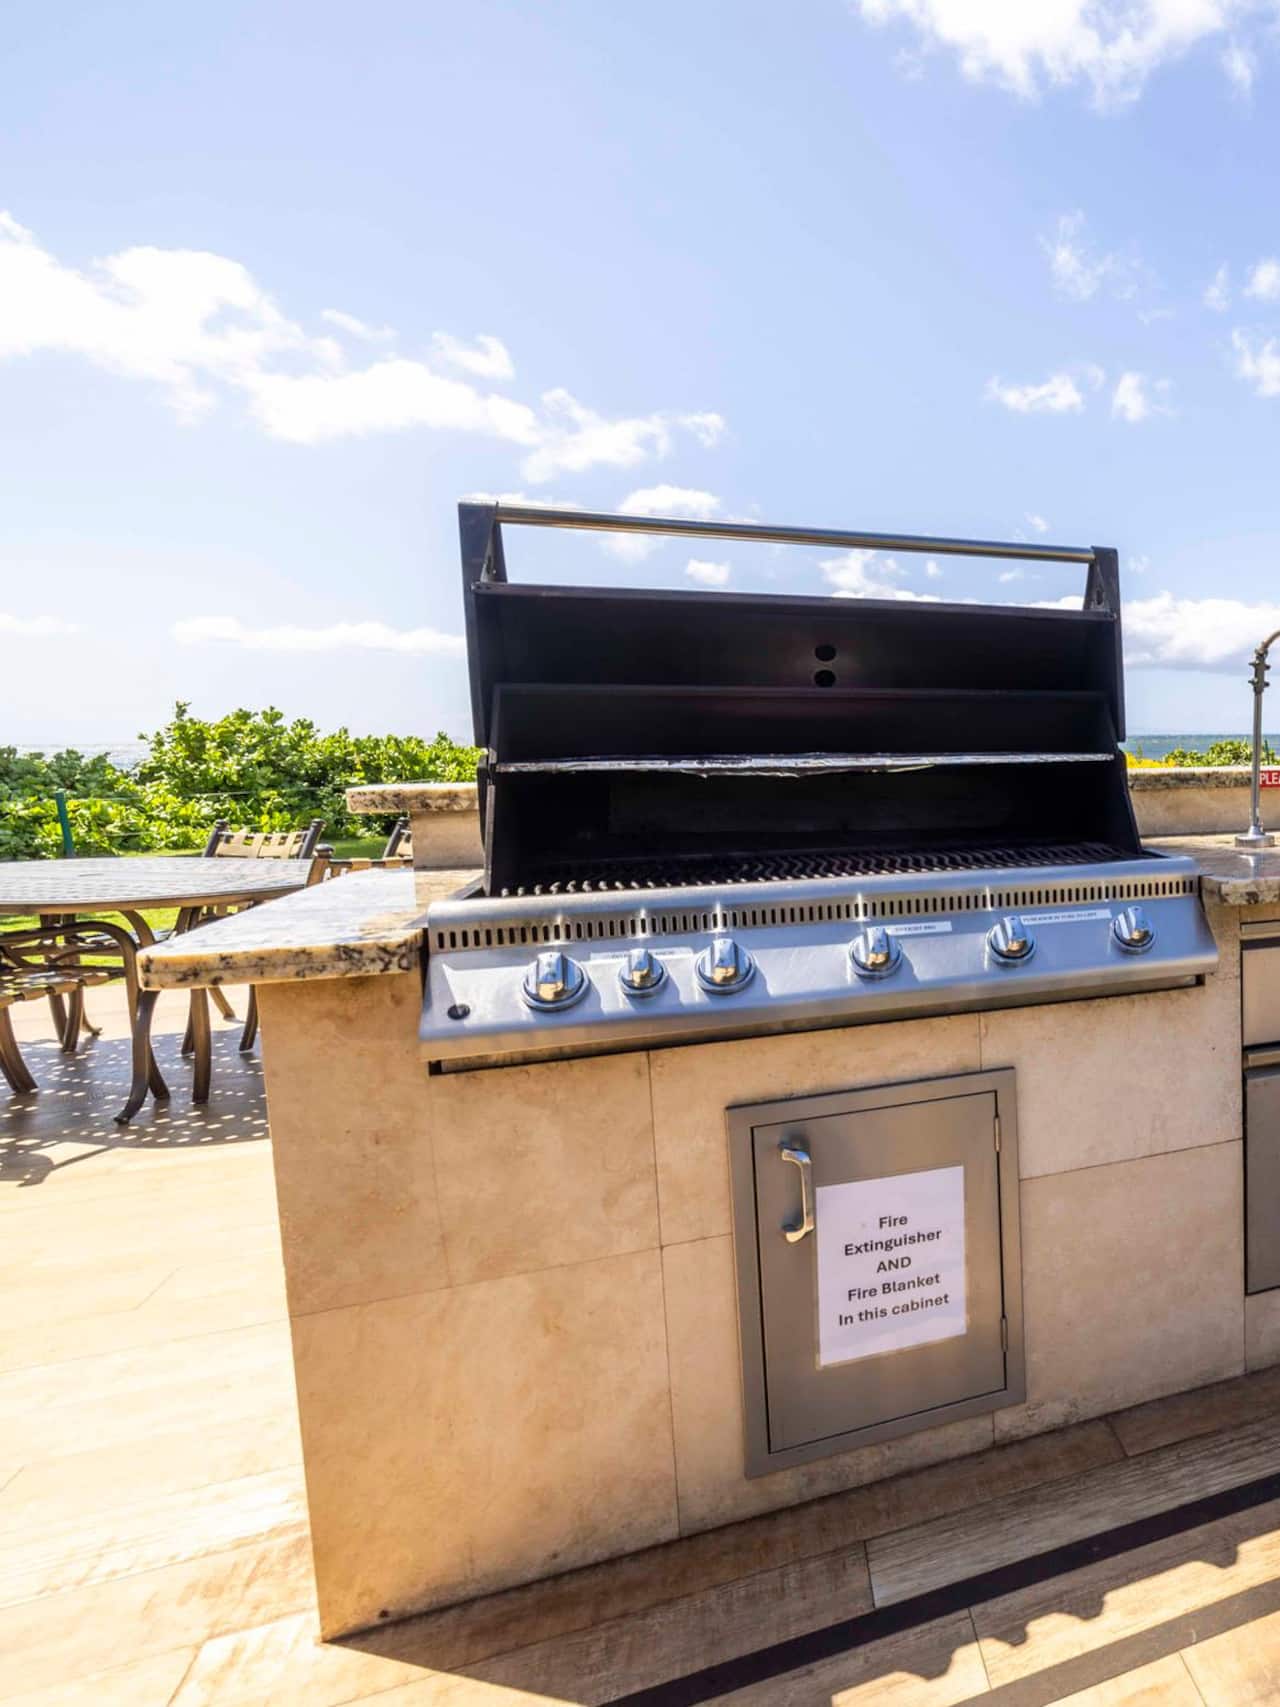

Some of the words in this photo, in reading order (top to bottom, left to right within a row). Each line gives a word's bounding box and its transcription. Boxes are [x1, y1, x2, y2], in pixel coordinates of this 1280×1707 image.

[879, 1214, 908, 1229] Fire
[844, 1229, 942, 1256] Extinguisher
[876, 1256, 911, 1273] AND
[848, 1286, 877, 1301] Fire
[882, 1273, 940, 1295] Blanket
[839, 1314, 853, 1326] In
[858, 1307, 887, 1322] this
[892, 1293, 950, 1316] cabinet
